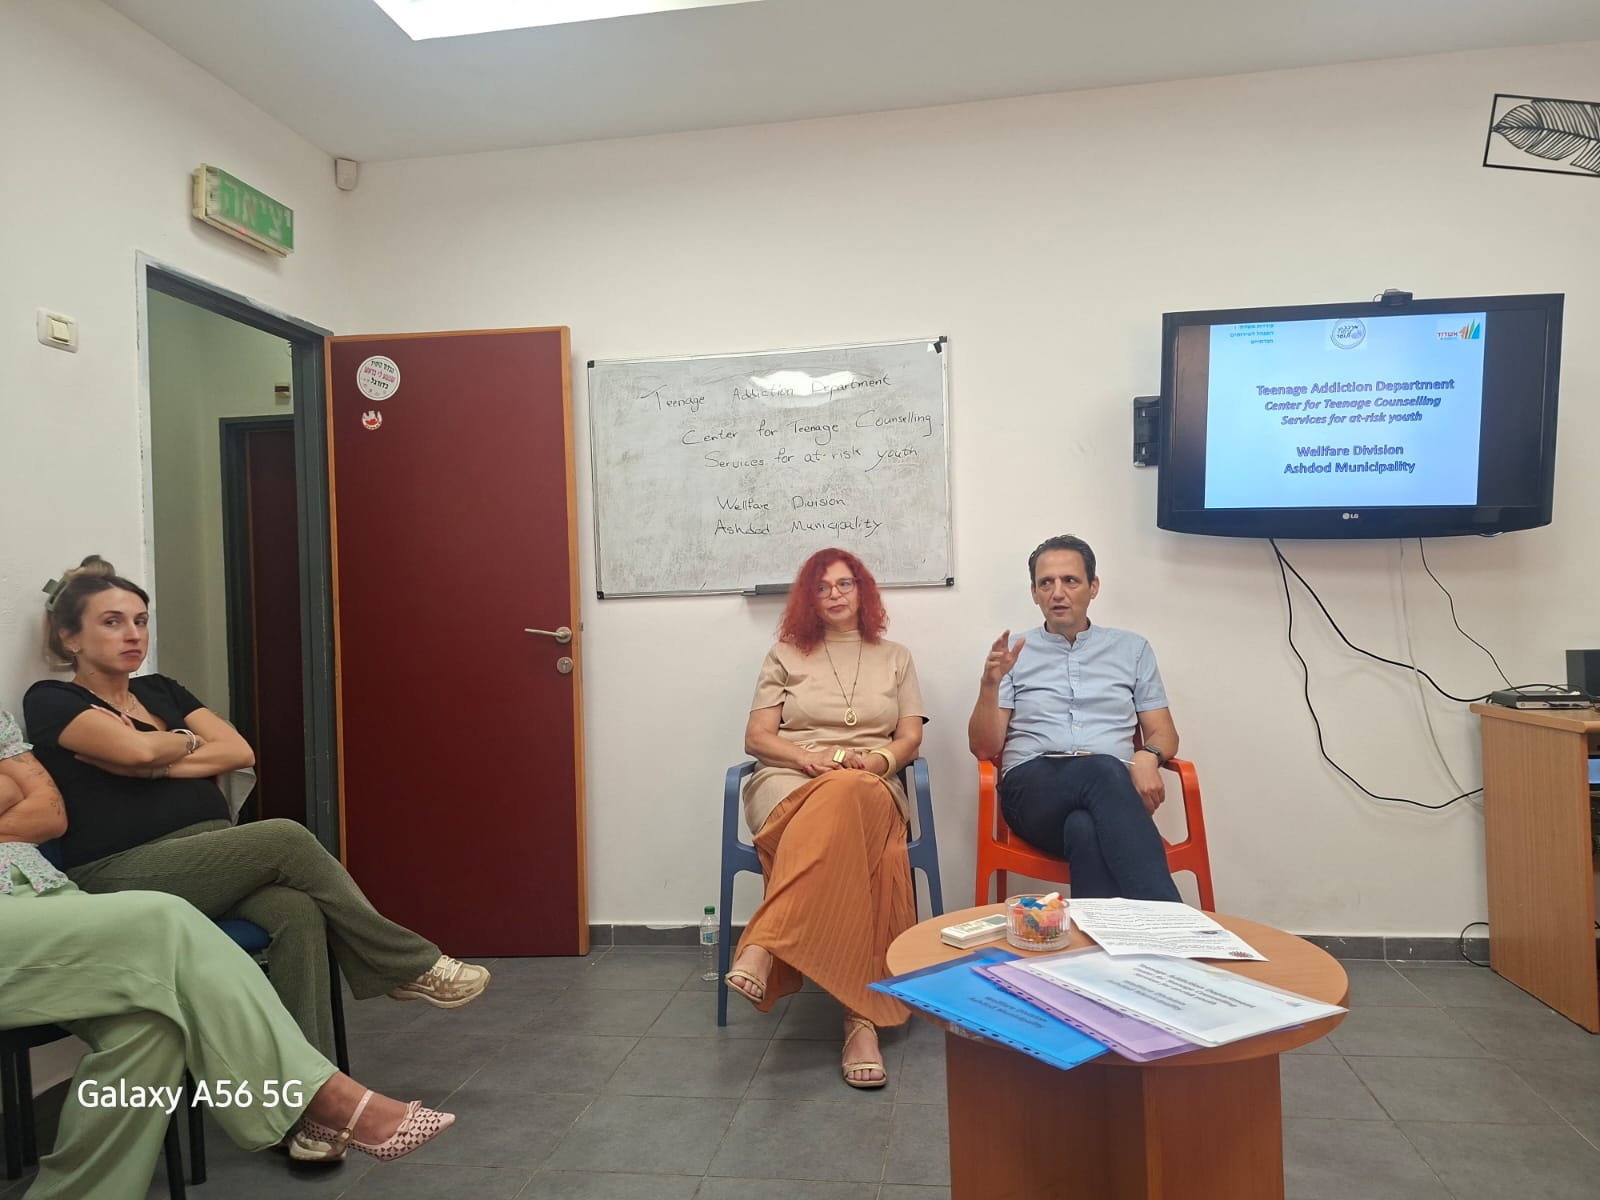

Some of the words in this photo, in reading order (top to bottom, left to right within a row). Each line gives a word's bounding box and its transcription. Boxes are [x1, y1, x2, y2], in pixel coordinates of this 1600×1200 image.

[640, 384, 705, 413] Teenage
[730, 386, 794, 401] Addiction
[811, 376, 892, 401] Department
[1256, 385, 1308, 396] Teenage
[1311, 382, 1372, 394] Addiction
[1376, 379, 1455, 393] Department
[1264, 400, 1302, 411] Center
[1303, 399, 1320, 411] for
[1323, 398, 1371, 410] Teenage
[1374, 395, 1441, 408] Counselling
[1281, 414, 1327, 425] Services
[1327, 413, 1346, 425] for
[1350, 411, 1386, 423] at-risk
[1388, 410, 1422, 424] youth
[682, 429, 739, 445] Center
[758, 419, 778, 437] for
[786, 419, 840, 446] Teenage
[856, 410, 932, 438] Counselling
[1353, 444, 1404, 456] Division
[704, 451, 765, 468] Services
[774, 448, 795, 463] for
[864, 447, 918, 473] youth
[1283, 463, 1332, 474] Ashdod
[1335, 461, 1416, 475] Municipality
[792, 495, 847, 511] Division
[715, 520, 770, 535] Ashdod
[791, 515, 883, 538] Municipality
